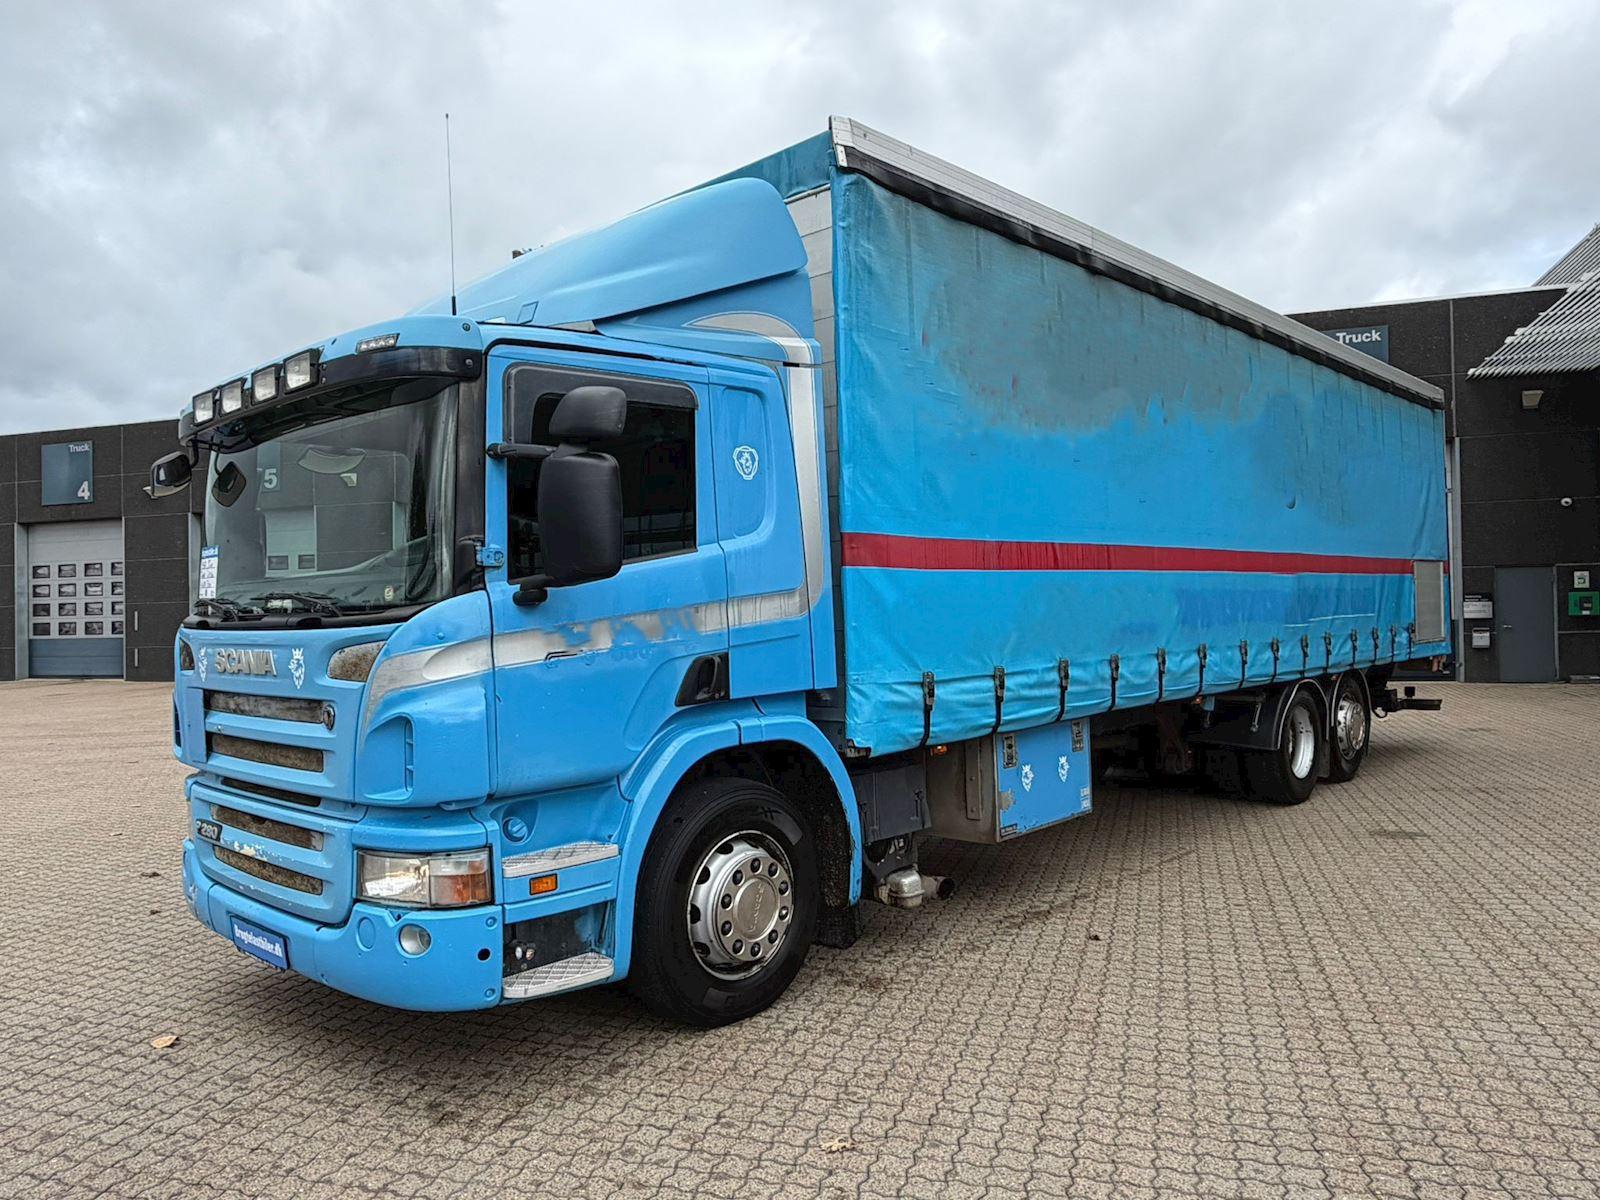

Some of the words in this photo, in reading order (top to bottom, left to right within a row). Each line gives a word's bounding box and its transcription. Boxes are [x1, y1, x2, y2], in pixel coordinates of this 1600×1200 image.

[1335, 329, 1382, 344] Truck
[68, 443, 90, 453] Truck
[263, 468, 278, 489] 5
[77, 480, 90, 500] 4
[214, 647, 277, 677] SCANIA
